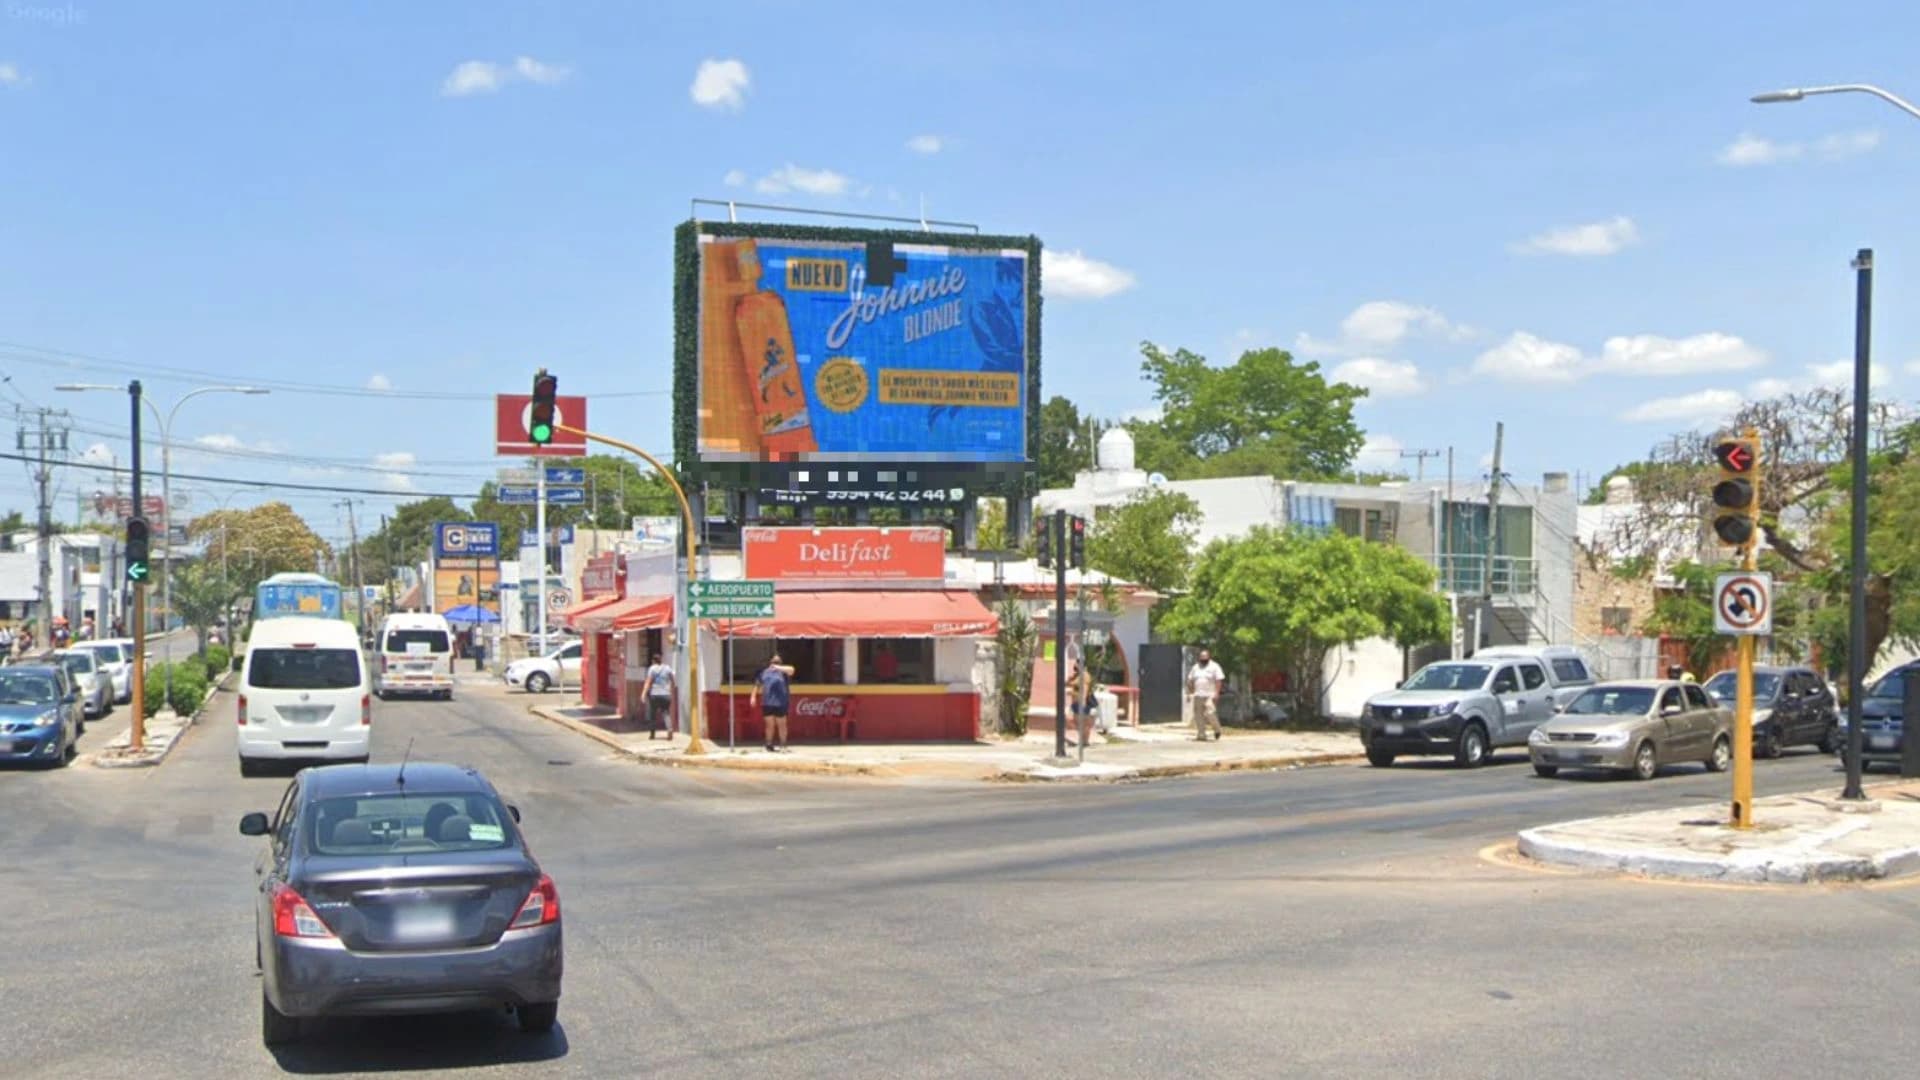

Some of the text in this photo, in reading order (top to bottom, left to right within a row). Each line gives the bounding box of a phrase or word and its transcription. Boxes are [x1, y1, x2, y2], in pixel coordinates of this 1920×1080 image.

[792, 263, 843, 288] NUEVO
[826, 264, 967, 349] Johnnie
[904, 300, 963, 343] BLONDE
[922, 488, 945, 501] 44
[800, 538, 893, 568] Delifast
[707, 584, 772, 596] AEROPUERTO
